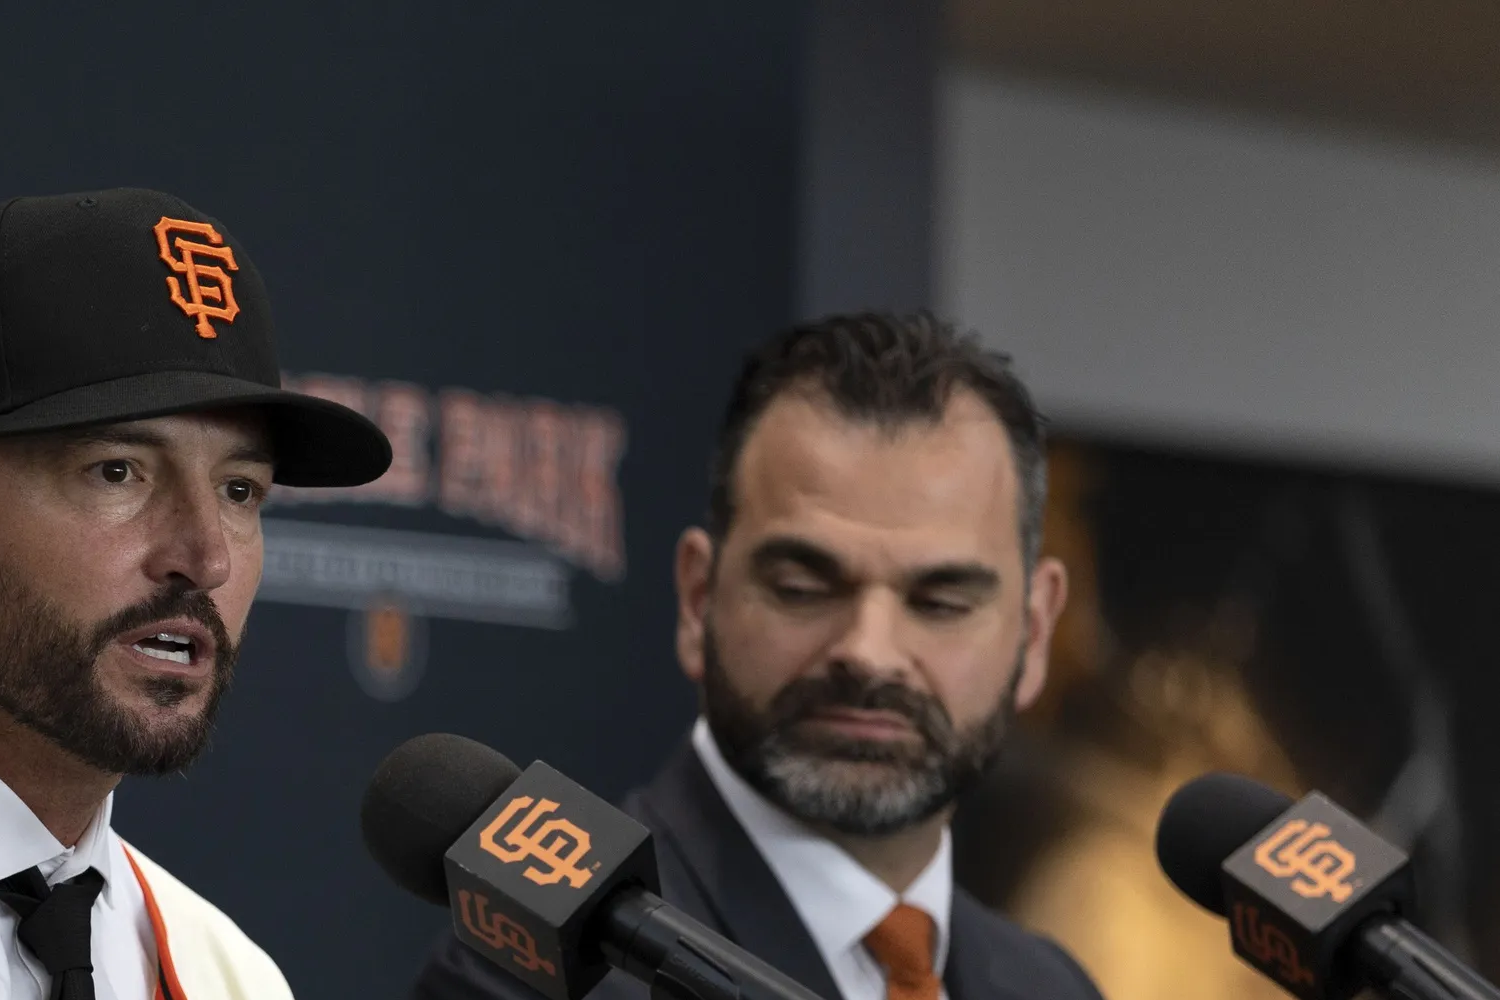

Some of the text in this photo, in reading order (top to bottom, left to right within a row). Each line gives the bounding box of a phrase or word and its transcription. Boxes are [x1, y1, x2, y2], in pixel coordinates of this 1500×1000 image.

[153, 216, 241, 339] SF
[480, 795, 593, 889] SF
[1254, 818, 1356, 904] SF
